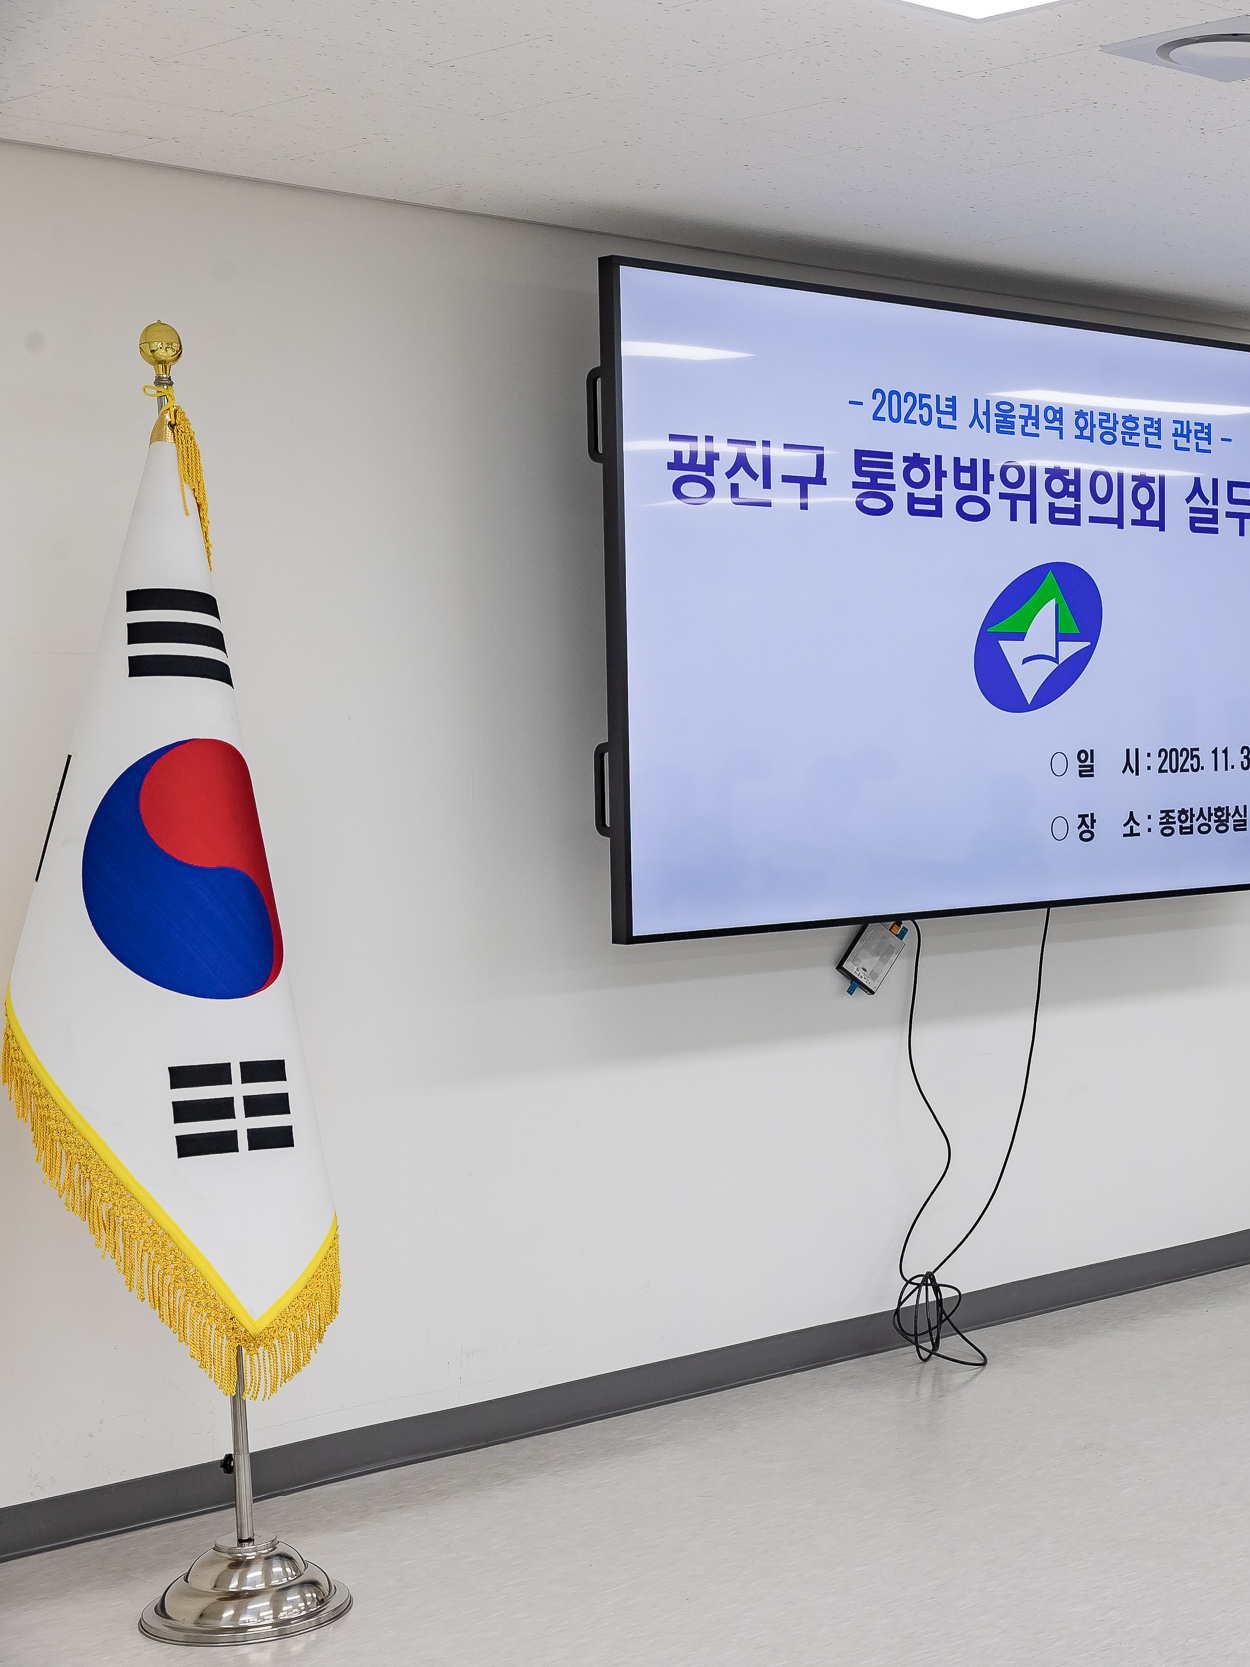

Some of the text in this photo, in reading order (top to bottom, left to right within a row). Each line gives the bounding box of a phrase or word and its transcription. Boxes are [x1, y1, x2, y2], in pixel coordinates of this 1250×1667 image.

[871, 388, 957, 431] 2025년
[968, 398, 1064, 440] 서울권역
[1074, 409, 1162, 449] 화랑훈련
[1172, 419, 1212, 454] 관련
[667, 433, 827, 511] 광진구
[852, 449, 1166, 532] 통합방위협의회
[1158, 747, 1205, 774] 2025.
[1211, 746, 1235, 772] 11.
[1077, 813, 1096, 842] 장
[1158, 804, 1248, 837] 종합상황실
